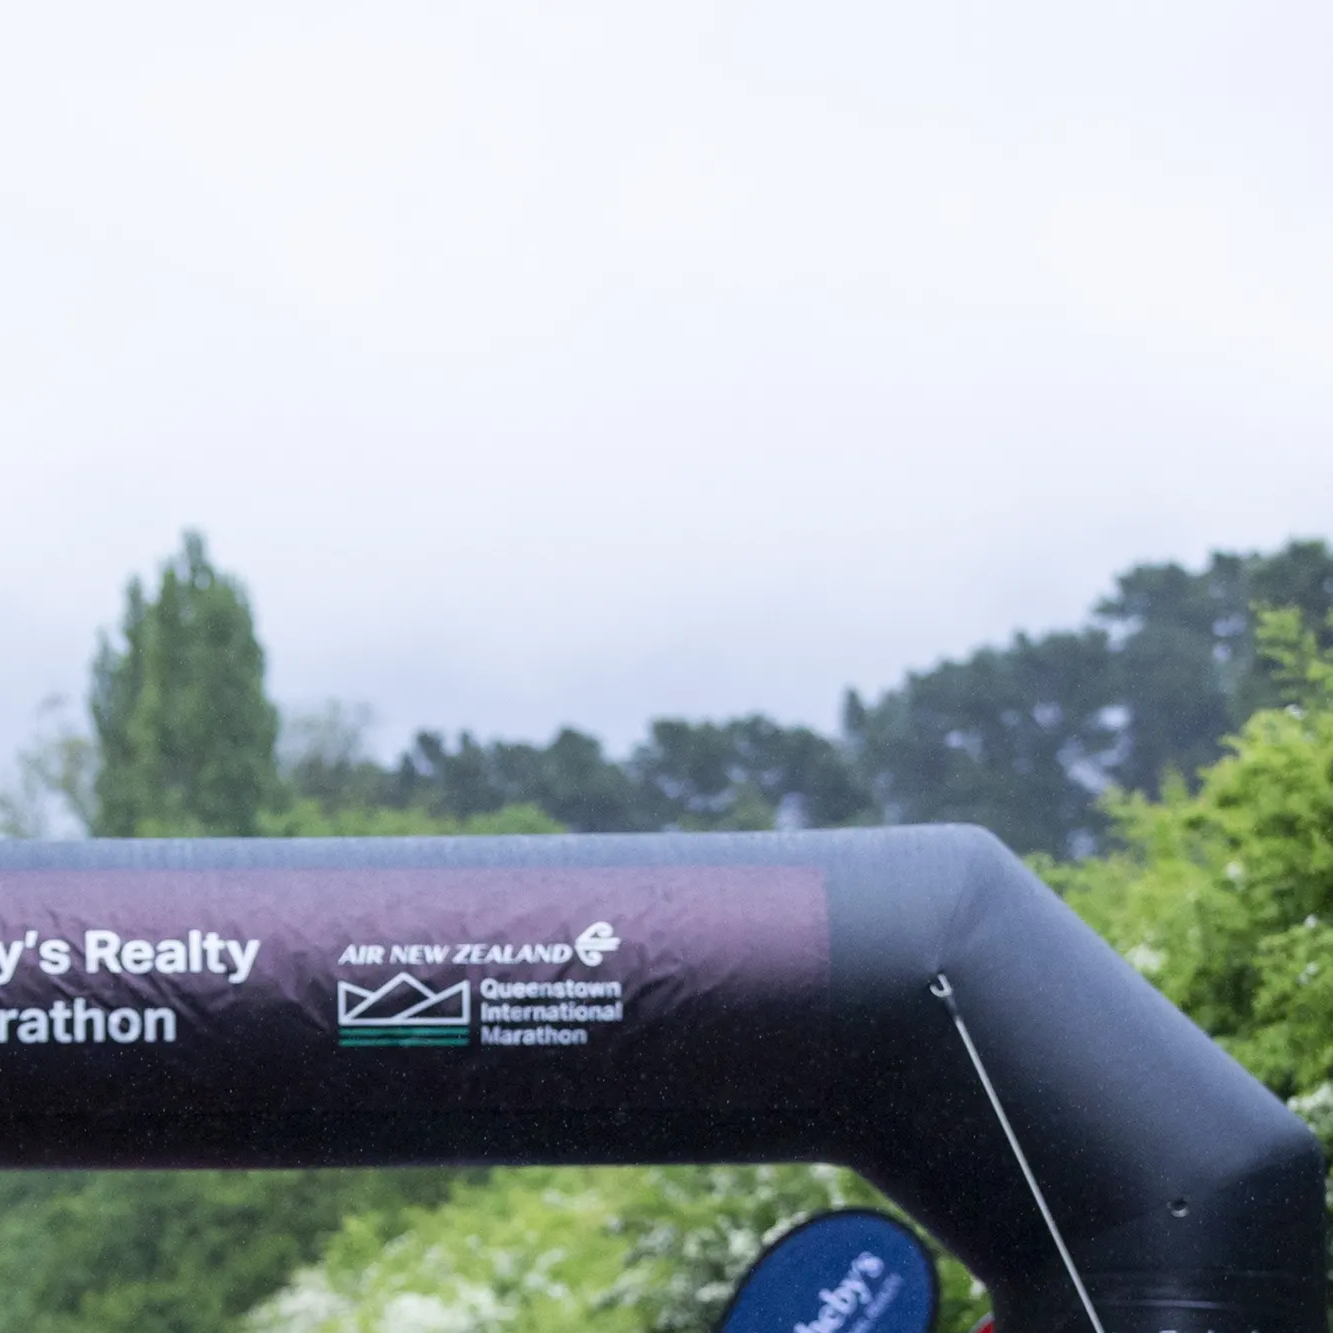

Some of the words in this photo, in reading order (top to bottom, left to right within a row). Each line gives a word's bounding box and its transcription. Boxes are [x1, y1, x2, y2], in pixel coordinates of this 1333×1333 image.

[84, 929, 261, 985] Realty
[338, 943, 386, 965] AIR
[390, 943, 451, 965] NEW
[452, 943, 574, 965] ZEALAND
[480, 978, 623, 999] Queenstown
[480, 1001, 624, 1022] International
[480, 1026, 588, 1045] Marathon
